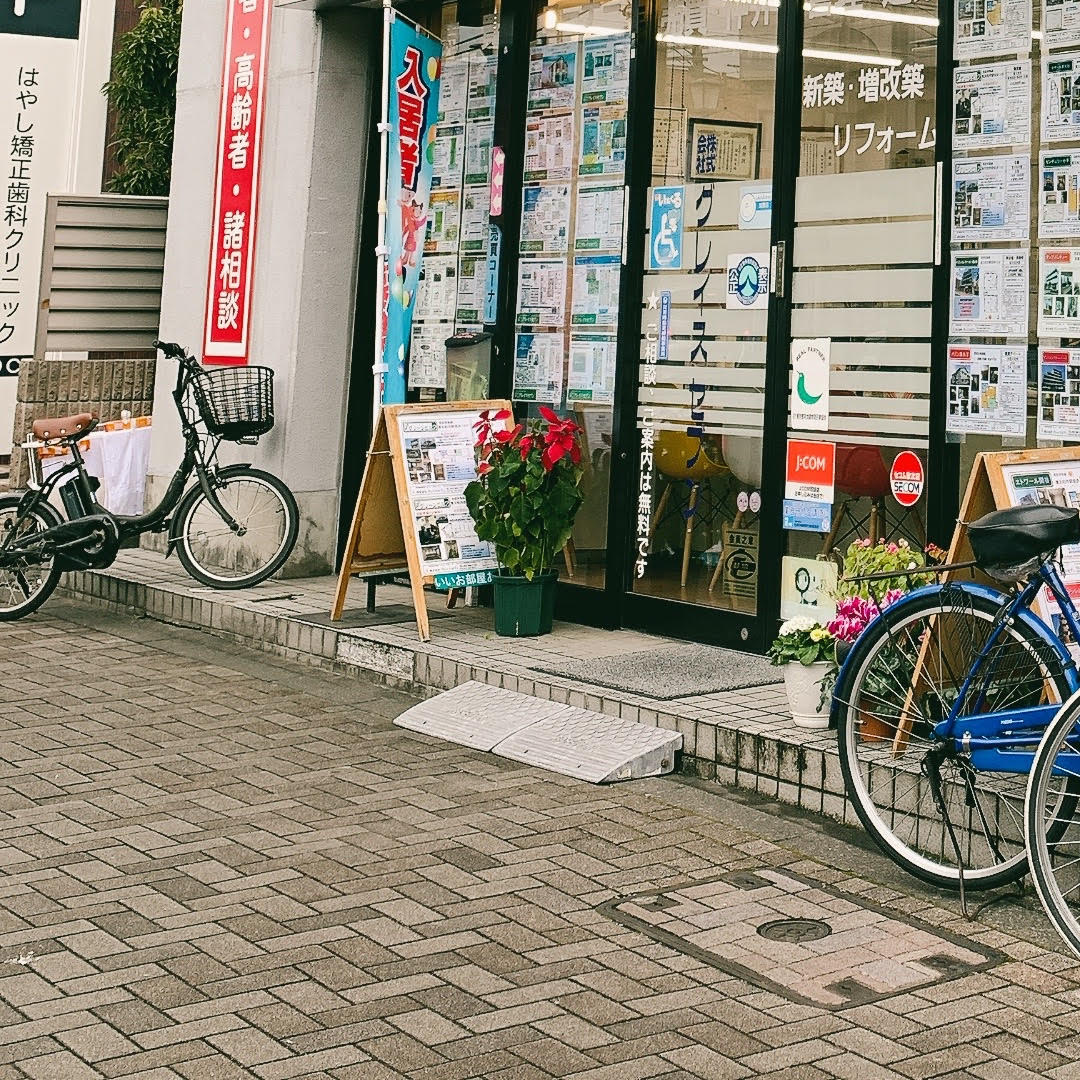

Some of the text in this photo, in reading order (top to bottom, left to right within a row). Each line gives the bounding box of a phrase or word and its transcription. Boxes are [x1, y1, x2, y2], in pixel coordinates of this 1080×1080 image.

[803, 63, 925, 108] 新築・増改築
[833, 117, 936, 157] リフォーム
[894, 482, 920, 494] SECOM
